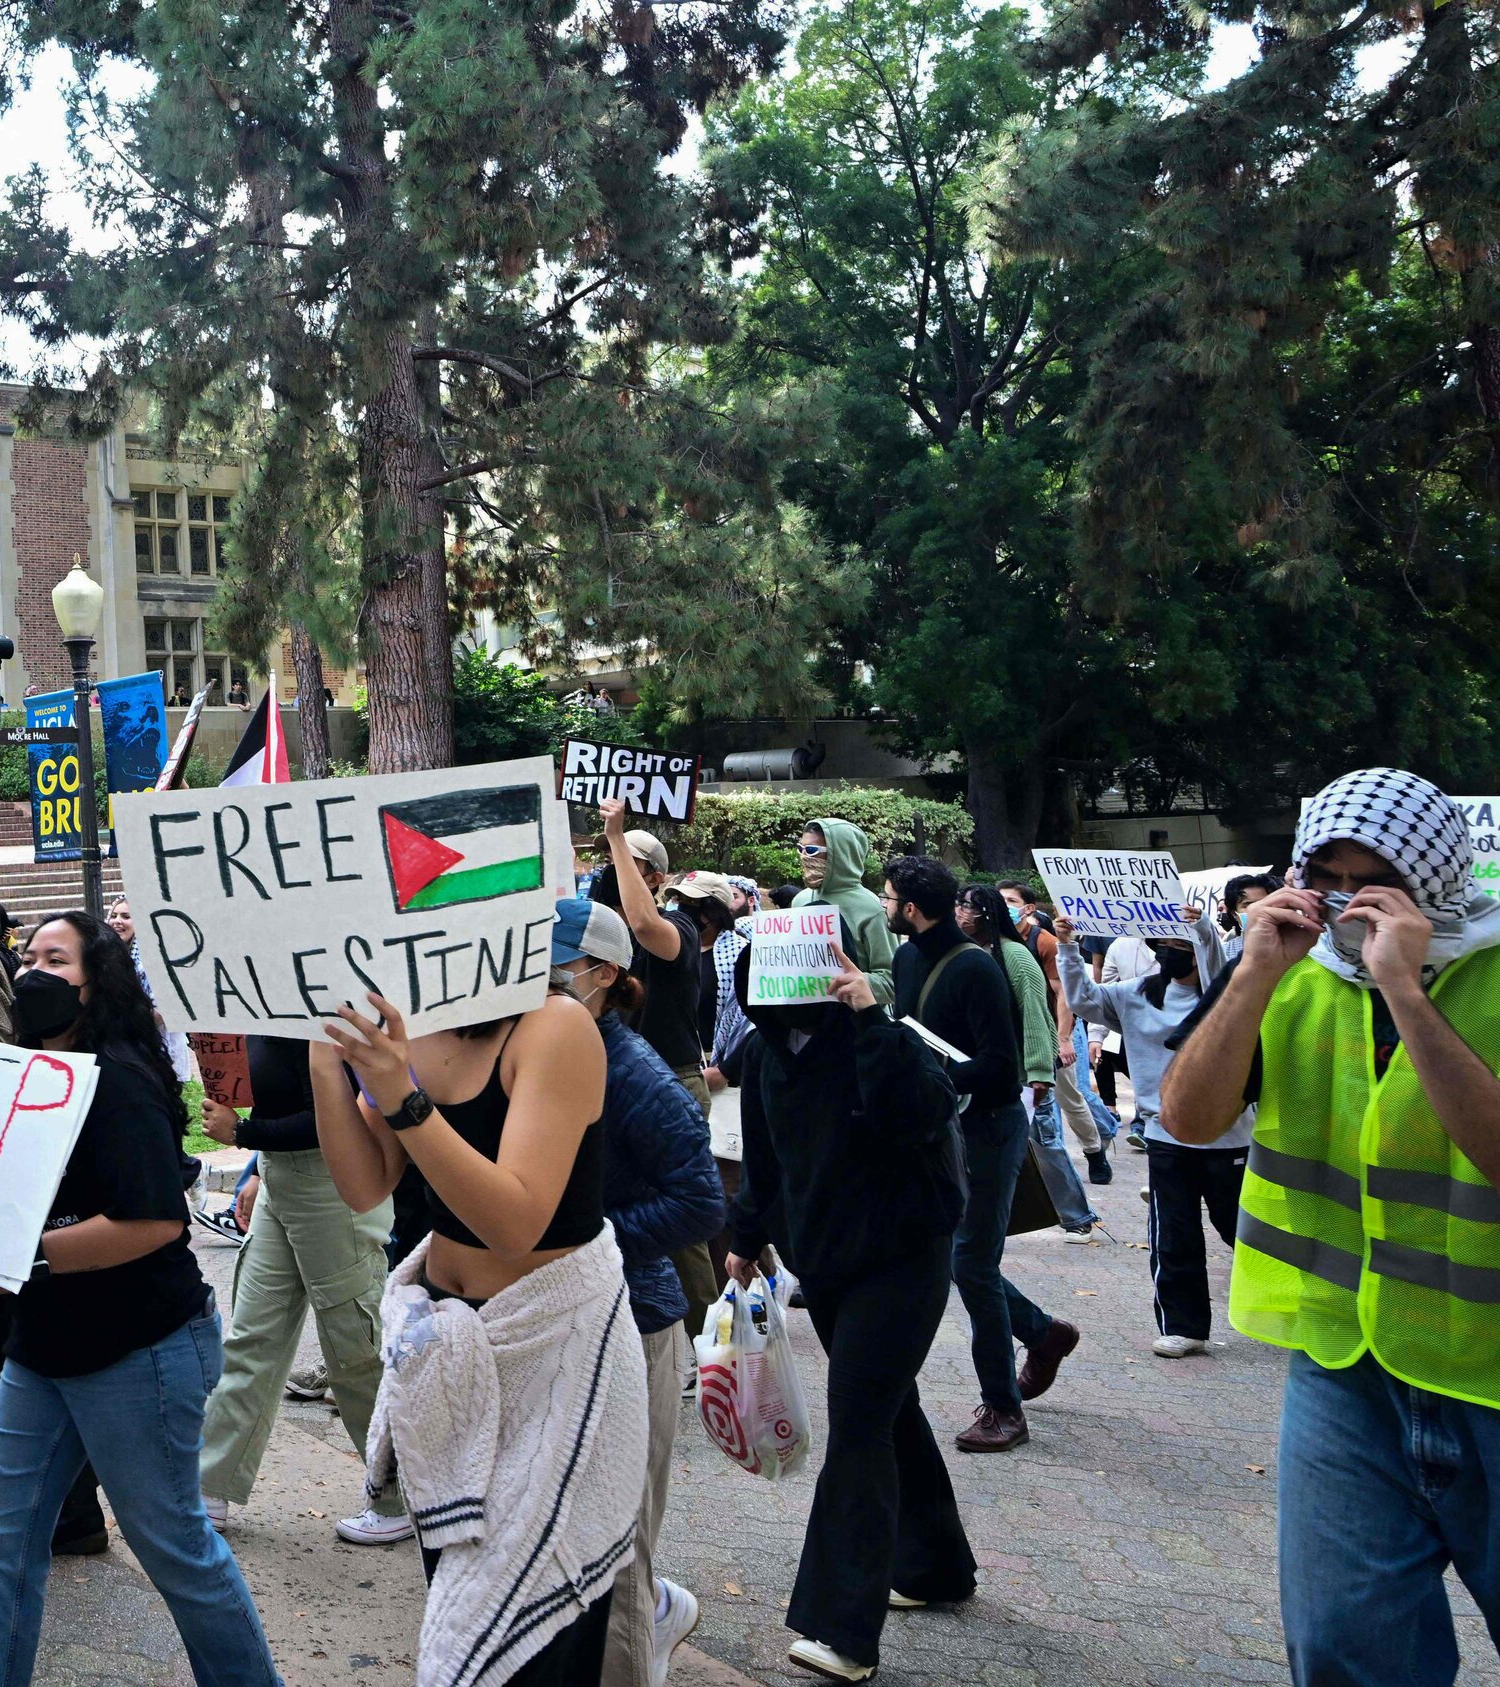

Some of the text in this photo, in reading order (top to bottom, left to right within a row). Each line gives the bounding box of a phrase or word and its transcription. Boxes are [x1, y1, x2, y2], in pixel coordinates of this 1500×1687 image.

[34, 704, 67, 717] WELCOME TO
[33, 732, 50, 740] HALL
[565, 741, 693, 774] RIGHT OF
[37, 755, 80, 795] GO
[561, 775, 691, 820] RETURN
[41, 840, 65, 849] ucla.edu
[149, 795, 362, 902] FREE
[1043, 857, 1180, 881] FROM THE RIVER
[1078, 878, 1098, 895] TO
[1100, 879, 1130, 898] THE
[1061, 896, 1189, 924] PALESTINE
[756, 914, 835, 935] LONG LIVE
[1069, 920, 1192, 939] WILL BE FREE!
[752, 942, 843, 969] INTERNATIONAL
[150, 908, 555, 1030] PALESTINE
[757, 975, 832, 998] SOLIDARIT
